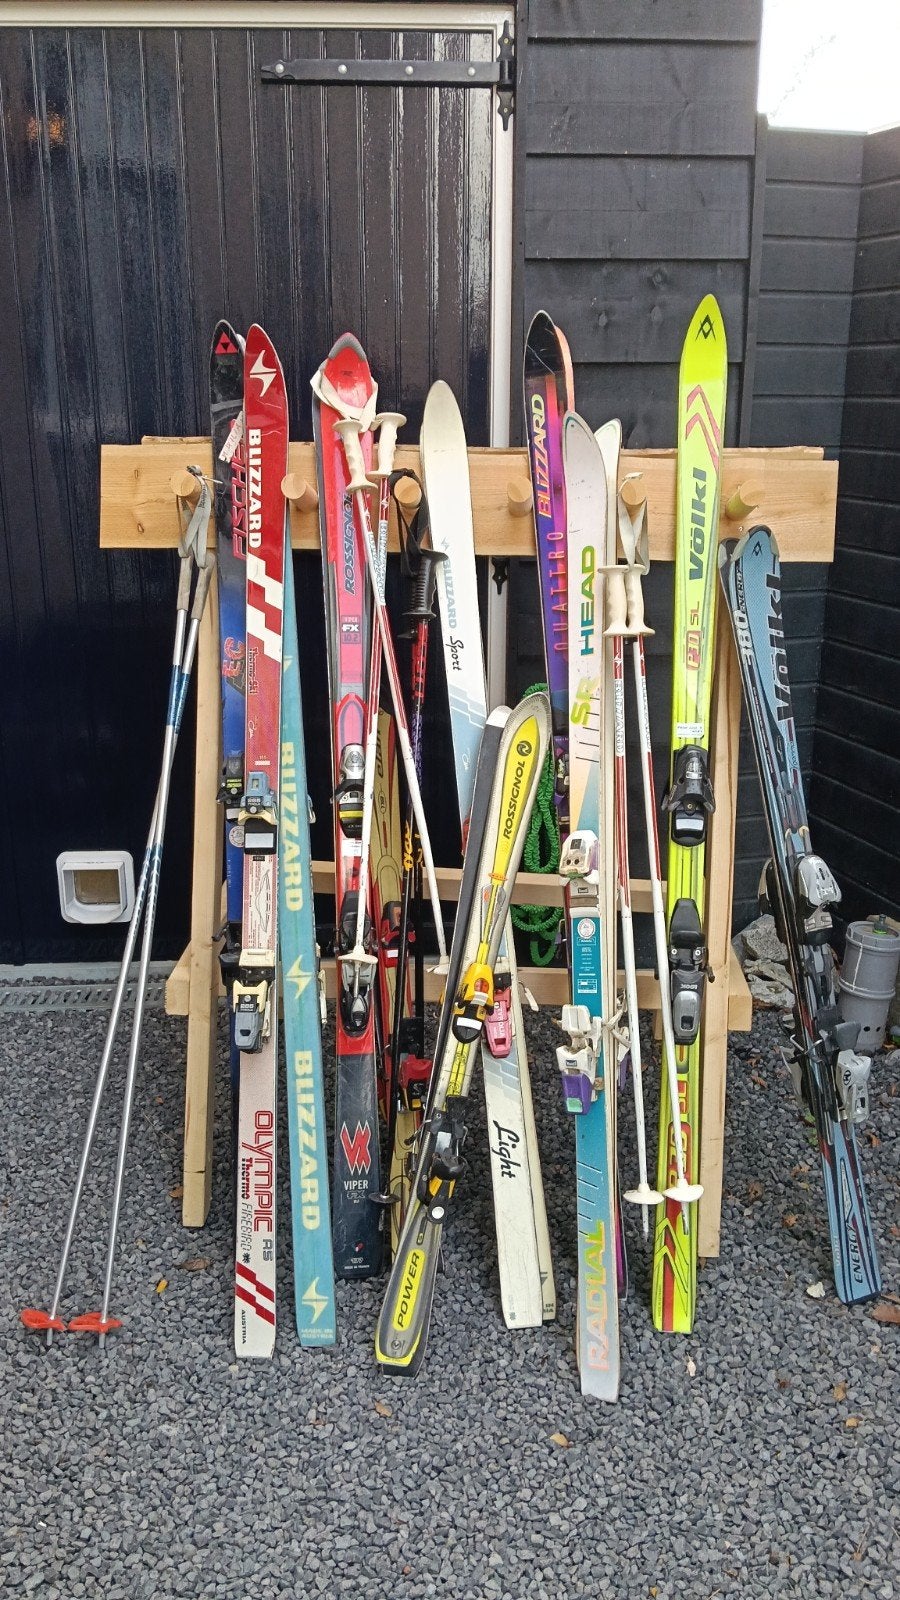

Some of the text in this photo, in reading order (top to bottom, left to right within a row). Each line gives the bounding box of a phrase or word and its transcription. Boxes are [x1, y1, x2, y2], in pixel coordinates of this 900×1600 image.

[231, 418, 247, 560] FISCHE
[248, 428, 262, 548] BLIZZARD
[531, 393, 552, 518] BLIZZARD
[343, 493, 356, 595] ROSSIGNOL
[341, 624, 360, 632] FX
[442, 556, 457, 629] BLIZZARD
[546, 531, 568, 651] QUATTRO
[580, 544, 596, 656] HEAD
[690, 600, 699, 626] SL
[446, 636, 464, 671] Sport
[732, 609, 756, 666] 380
[571, 674, 600, 727] SR
[281, 741, 304, 912] BLIZZARD
[503, 760, 526, 841] ROSSIGNOL
[241, 1110, 274, 1233] OLYMPIC
[241, 1157, 253, 1200] Thermo
[293, 1050, 321, 1231] BLIZZARD
[492, 1119, 522, 1179] Light
[343, 1179, 369, 1191] VIPER
[397, 1251, 421, 1329] POWER
[847, 1221, 864, 1284] ENERGY
[584, 1218, 610, 1371] RADIAL
